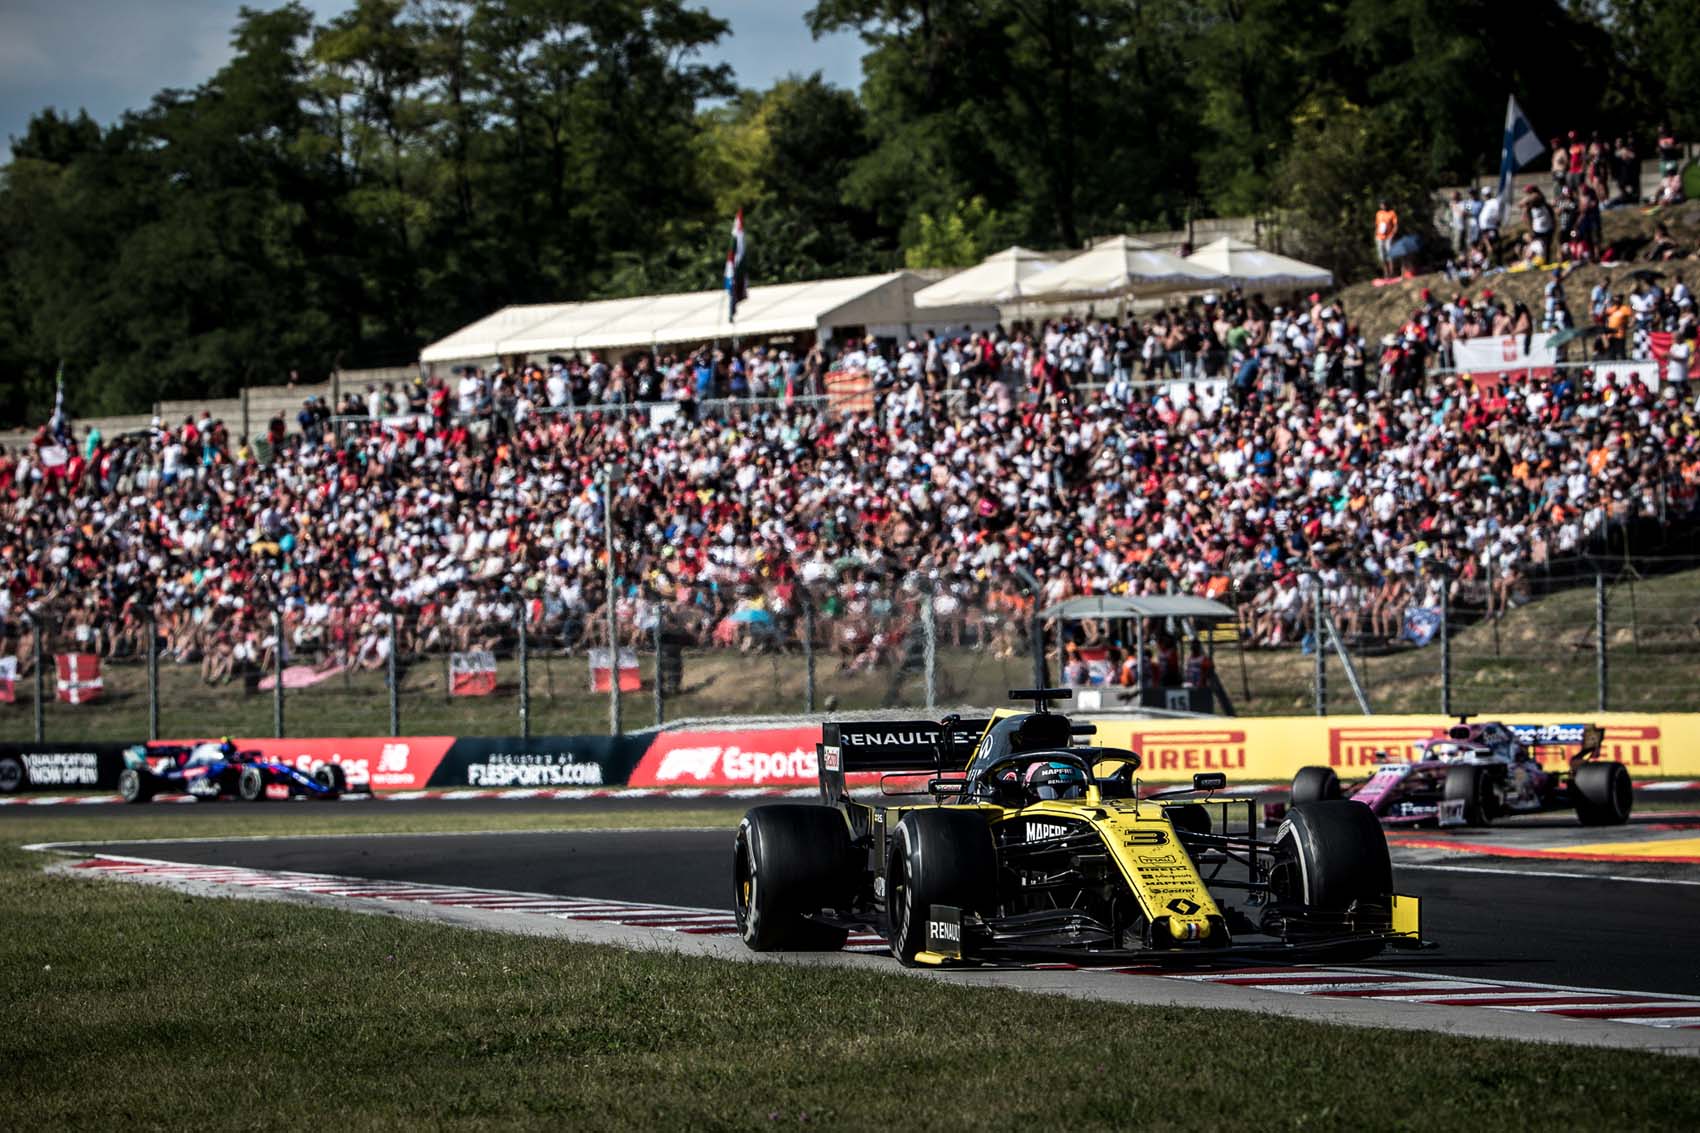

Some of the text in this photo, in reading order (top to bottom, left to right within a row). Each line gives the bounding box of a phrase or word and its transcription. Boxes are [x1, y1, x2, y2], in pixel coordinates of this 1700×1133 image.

[723, 746, 818, 784] Esports
[1131, 731, 1246, 770] PIRELLI
[30, 767, 98, 784] NOW OPEN
[296, 753, 369, 784] Sees
[1124, 829, 1170, 848] 3
